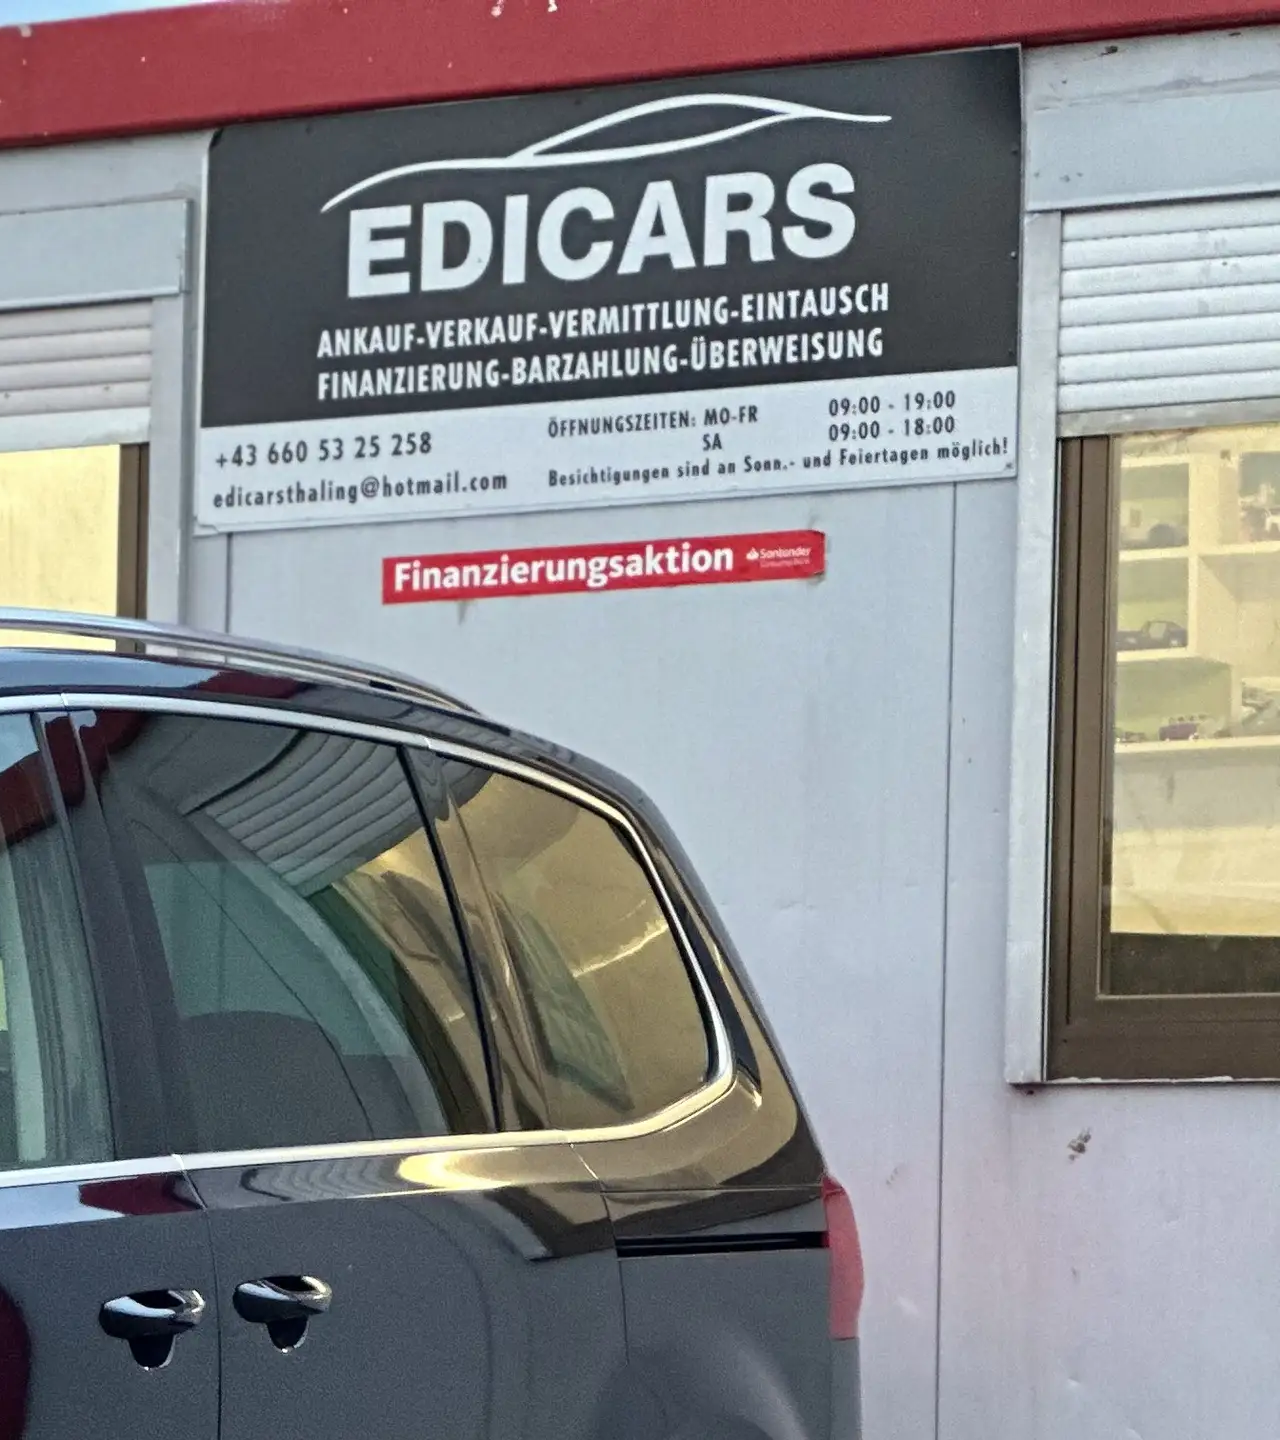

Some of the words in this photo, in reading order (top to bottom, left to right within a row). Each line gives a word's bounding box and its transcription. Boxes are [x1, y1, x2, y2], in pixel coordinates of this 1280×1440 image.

[347, 162, 856, 298] EDICARS
[317, 283, 889, 358] ANKAUF-VERKAUF-VERMITTLUNG-EINTAUSCH
[317, 327, 884, 400] FINANZIERUNG-BARZAHLUNG-ÜBERWEISUNG
[547, 410, 697, 438] ÖFFNUNGSZEITEN:
[703, 405, 759, 426] MO-FR
[828, 396, 881, 418] 09:00
[903, 390, 957, 411] 19:00
[701, 433, 723, 451] SA
[828, 420, 881, 442] 09:00
[903, 415, 956, 436] 18:00
[215, 443, 258, 468] +43
[267, 440, 308, 464] 660
[318, 437, 344, 462] 53
[354, 434, 381, 459] 25
[391, 431, 433, 456] 258
[548, 465, 670, 487] Besichtigungen
[676, 458, 710, 478] sind
[716, 461, 737, 476] an
[802, 450, 832, 469] und
[839, 447, 929, 466] Feiertagen
[936, 437, 1009, 461] möglich!
[213, 471, 508, 509] edicarsthaling@hotmail.com
[394, 542, 735, 592] Finanzierungsaktion
